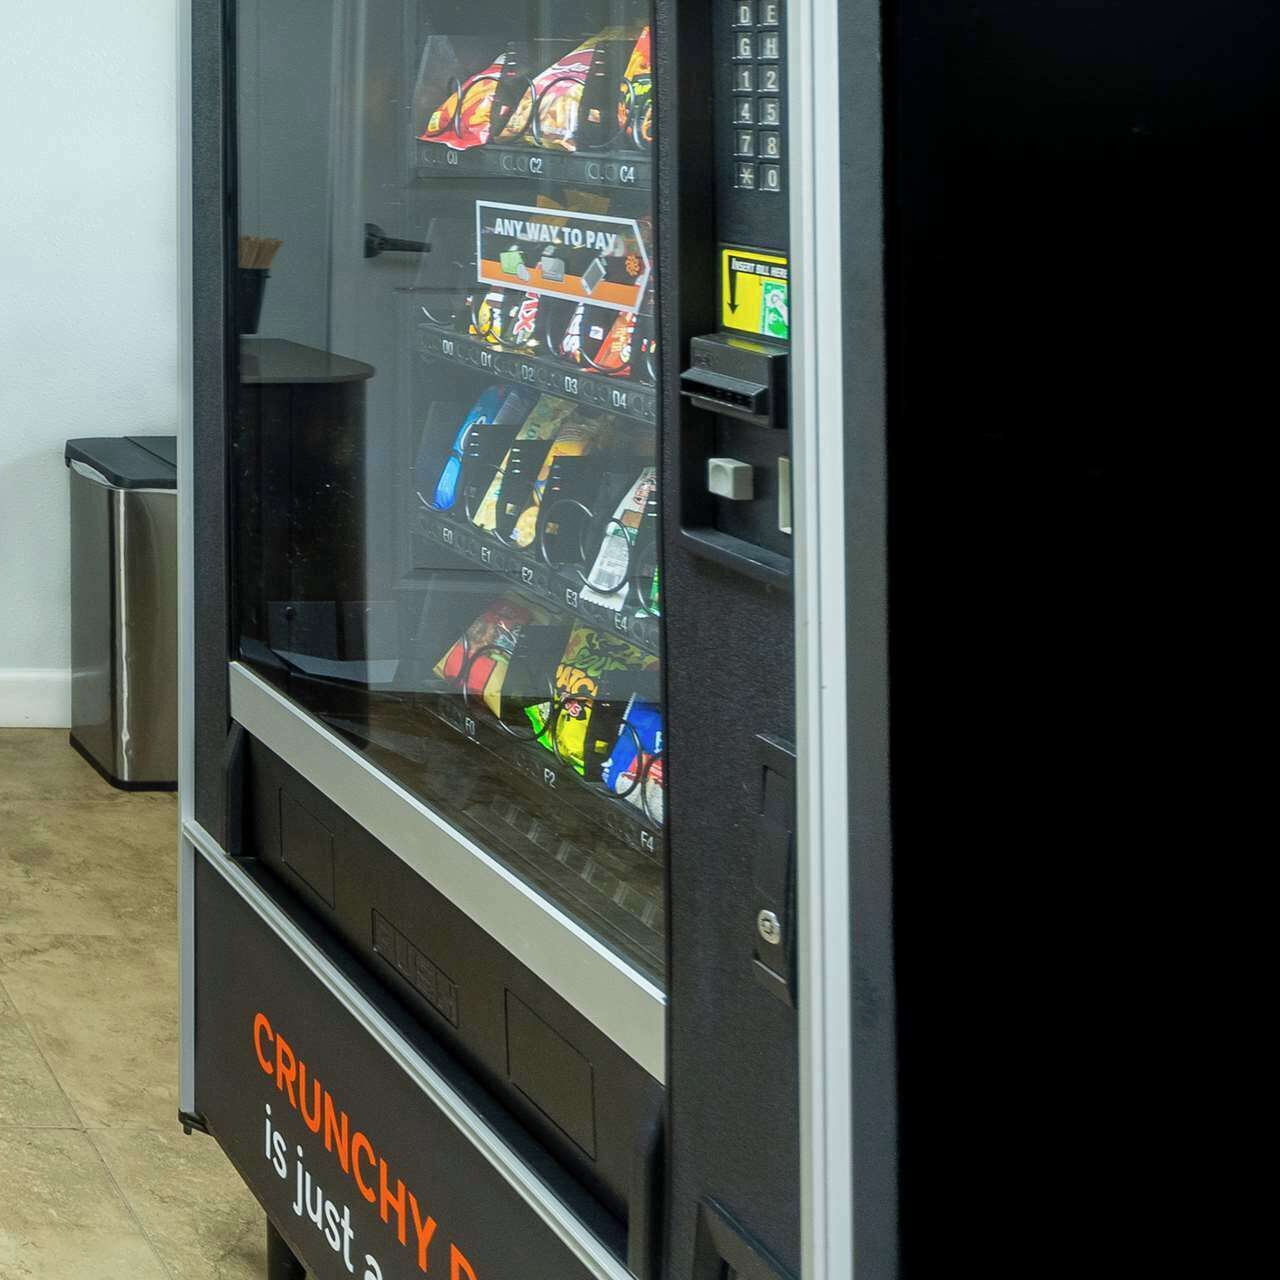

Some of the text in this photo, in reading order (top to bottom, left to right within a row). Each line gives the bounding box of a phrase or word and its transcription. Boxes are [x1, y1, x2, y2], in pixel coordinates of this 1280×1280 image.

[740, 6, 750, 20] D
[767, 4, 777, 19] E
[740, 37, 751, 55] G
[766, 37, 777, 55] H
[742, 70, 750, 88] 1
[767, 70, 776, 89] 2
[741, 103, 750, 120] 4
[768, 103, 776, 121] 5
[741, 135, 751, 153] 7
[767, 136, 777, 154] 8
[529, 158, 542, 173] C2
[620, 166, 635, 183] C4
[768, 169, 777, 187] 0
[494, 218, 617, 250] ANY WAY TO PAY
[732, 257, 755, 272] INSERT
[756, 264, 770, 276] BILL
[564, 376, 578, 394] D3
[612, 390, 627, 408] D4
[641, 831, 655, 852] F4
[253, 1012, 437, 1273] CRUNCHY
[265, 1103, 287, 1179] is
[293, 1145, 354, 1273] just
